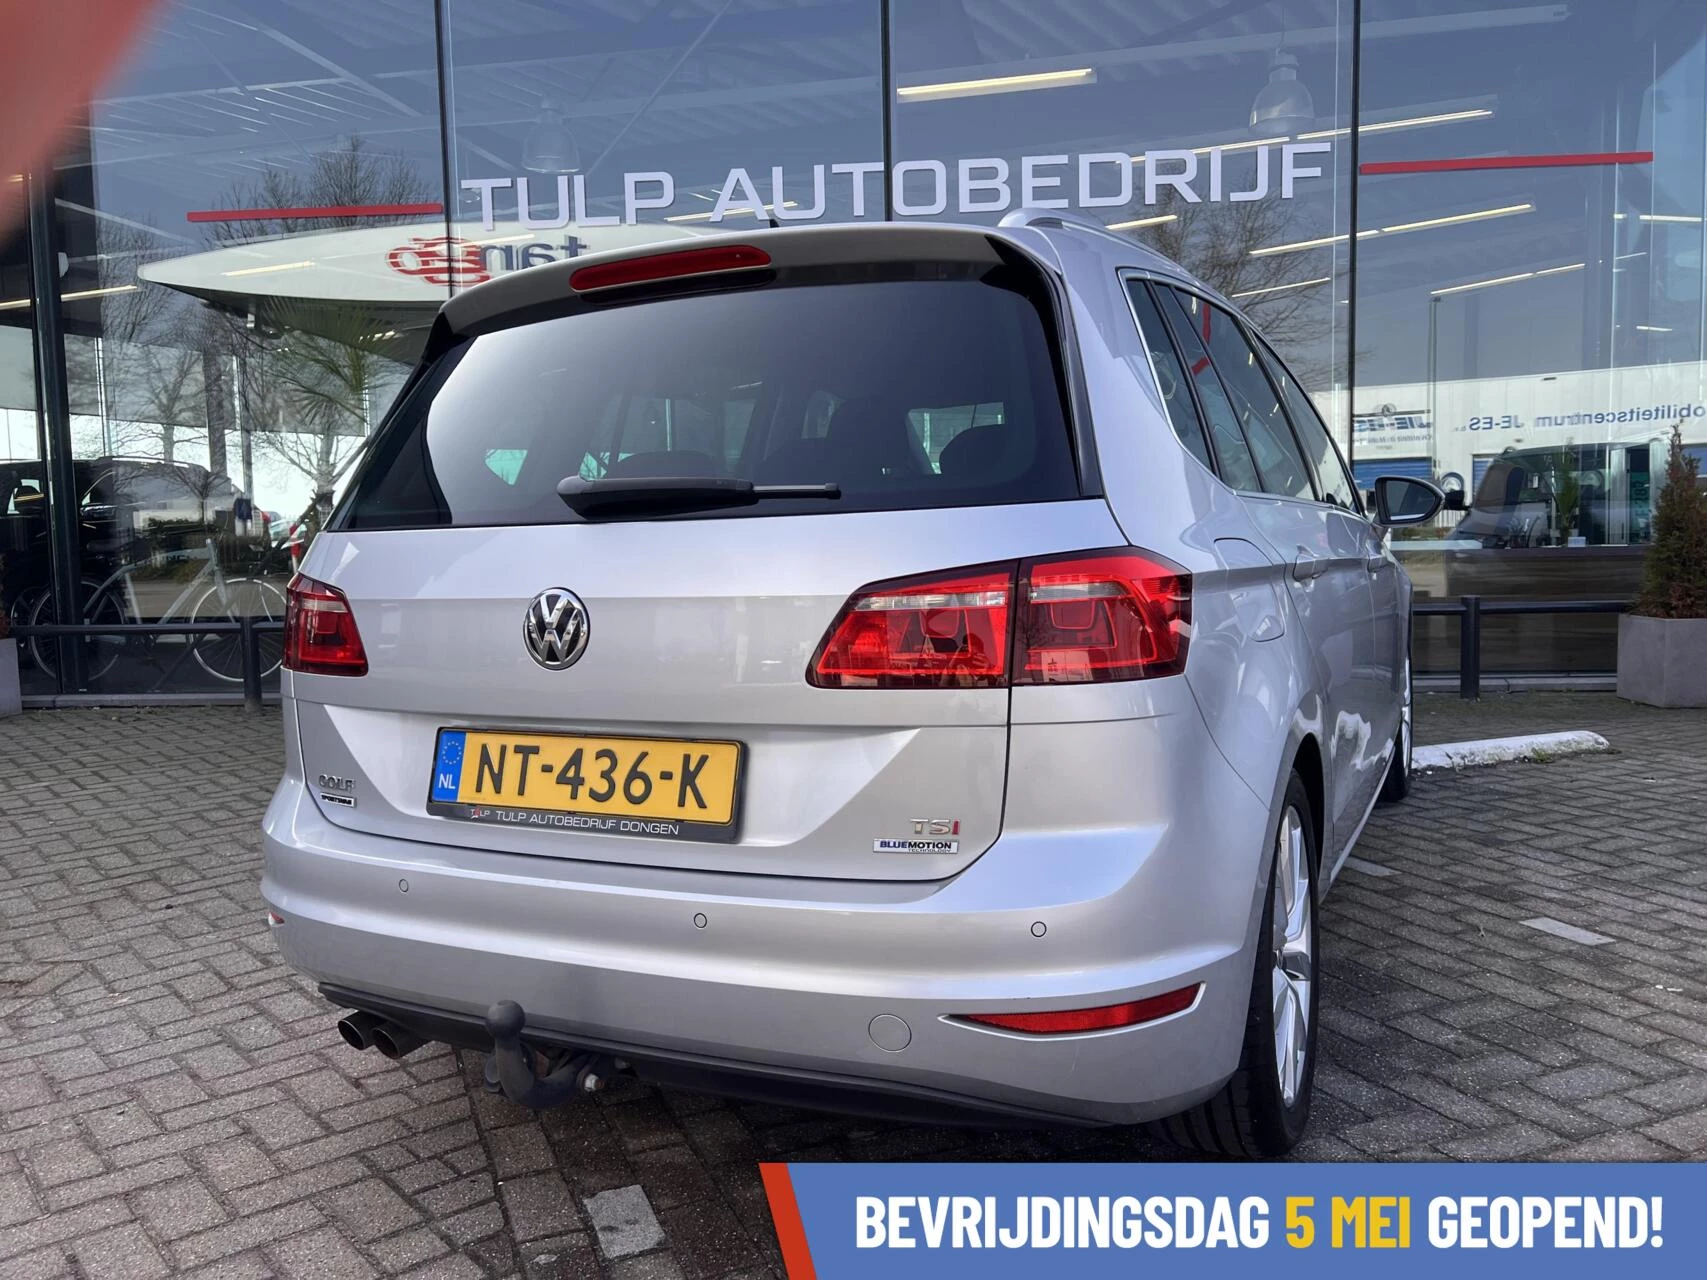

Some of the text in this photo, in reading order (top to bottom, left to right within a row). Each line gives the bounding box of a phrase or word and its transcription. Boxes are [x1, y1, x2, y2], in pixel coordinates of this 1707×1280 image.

[461, 142, 1332, 231] TULP AUTOBEDRIJF
[319, 774, 356, 792] GOLF
[438, 773, 456, 790] NL
[475, 743, 708, 809] NT-436-K
[496, 811, 527, 823] TULP
[529, 814, 616, 830] AUTOBEDRIJF
[620, 821, 679, 836] DONGEN
[909, 818, 960, 836] TSI
[879, 840, 952, 849] BLUEMOTION
